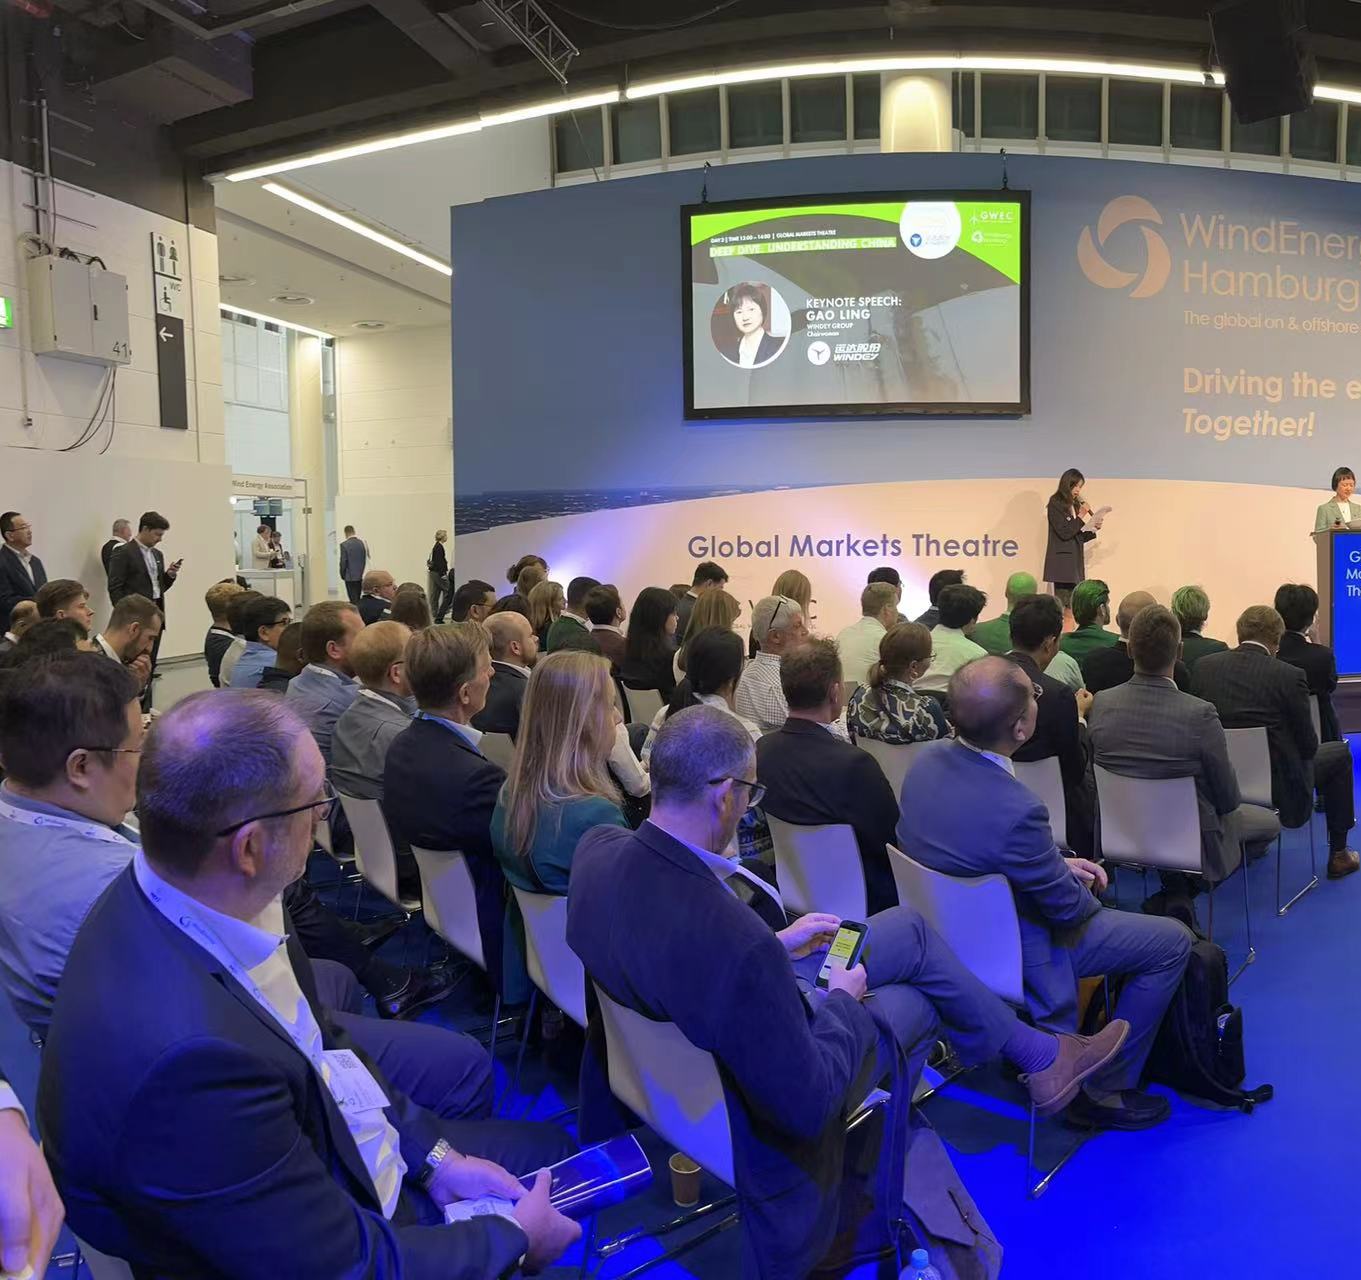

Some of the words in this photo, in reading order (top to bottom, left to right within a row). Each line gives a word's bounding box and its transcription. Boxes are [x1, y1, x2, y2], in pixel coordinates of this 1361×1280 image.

[1184, 259, 1360, 312] Hamburg
[806, 297, 855, 309] KEYNOTE
[858, 296, 902, 307] SPEECH:
[806, 310, 835, 321] GAO
[840, 309, 871, 320] LING
[1184, 310, 1210, 325] The
[1214, 312, 1262, 329] global
[1264, 319, 1284, 329] on
[1288, 319, 1299, 330] &
[1302, 317, 1359, 334] offshore
[113, 341, 128, 357] 41
[833, 353, 879, 361] WINDEY
[1184, 368, 1283, 402] Driving
[1291, 371, 1336, 399] the
[1182, 408, 1315, 441] Together!
[688, 535, 779, 558] Global
[789, 534, 902, 557] Markets
[912, 534, 1018, 557] Theatre
